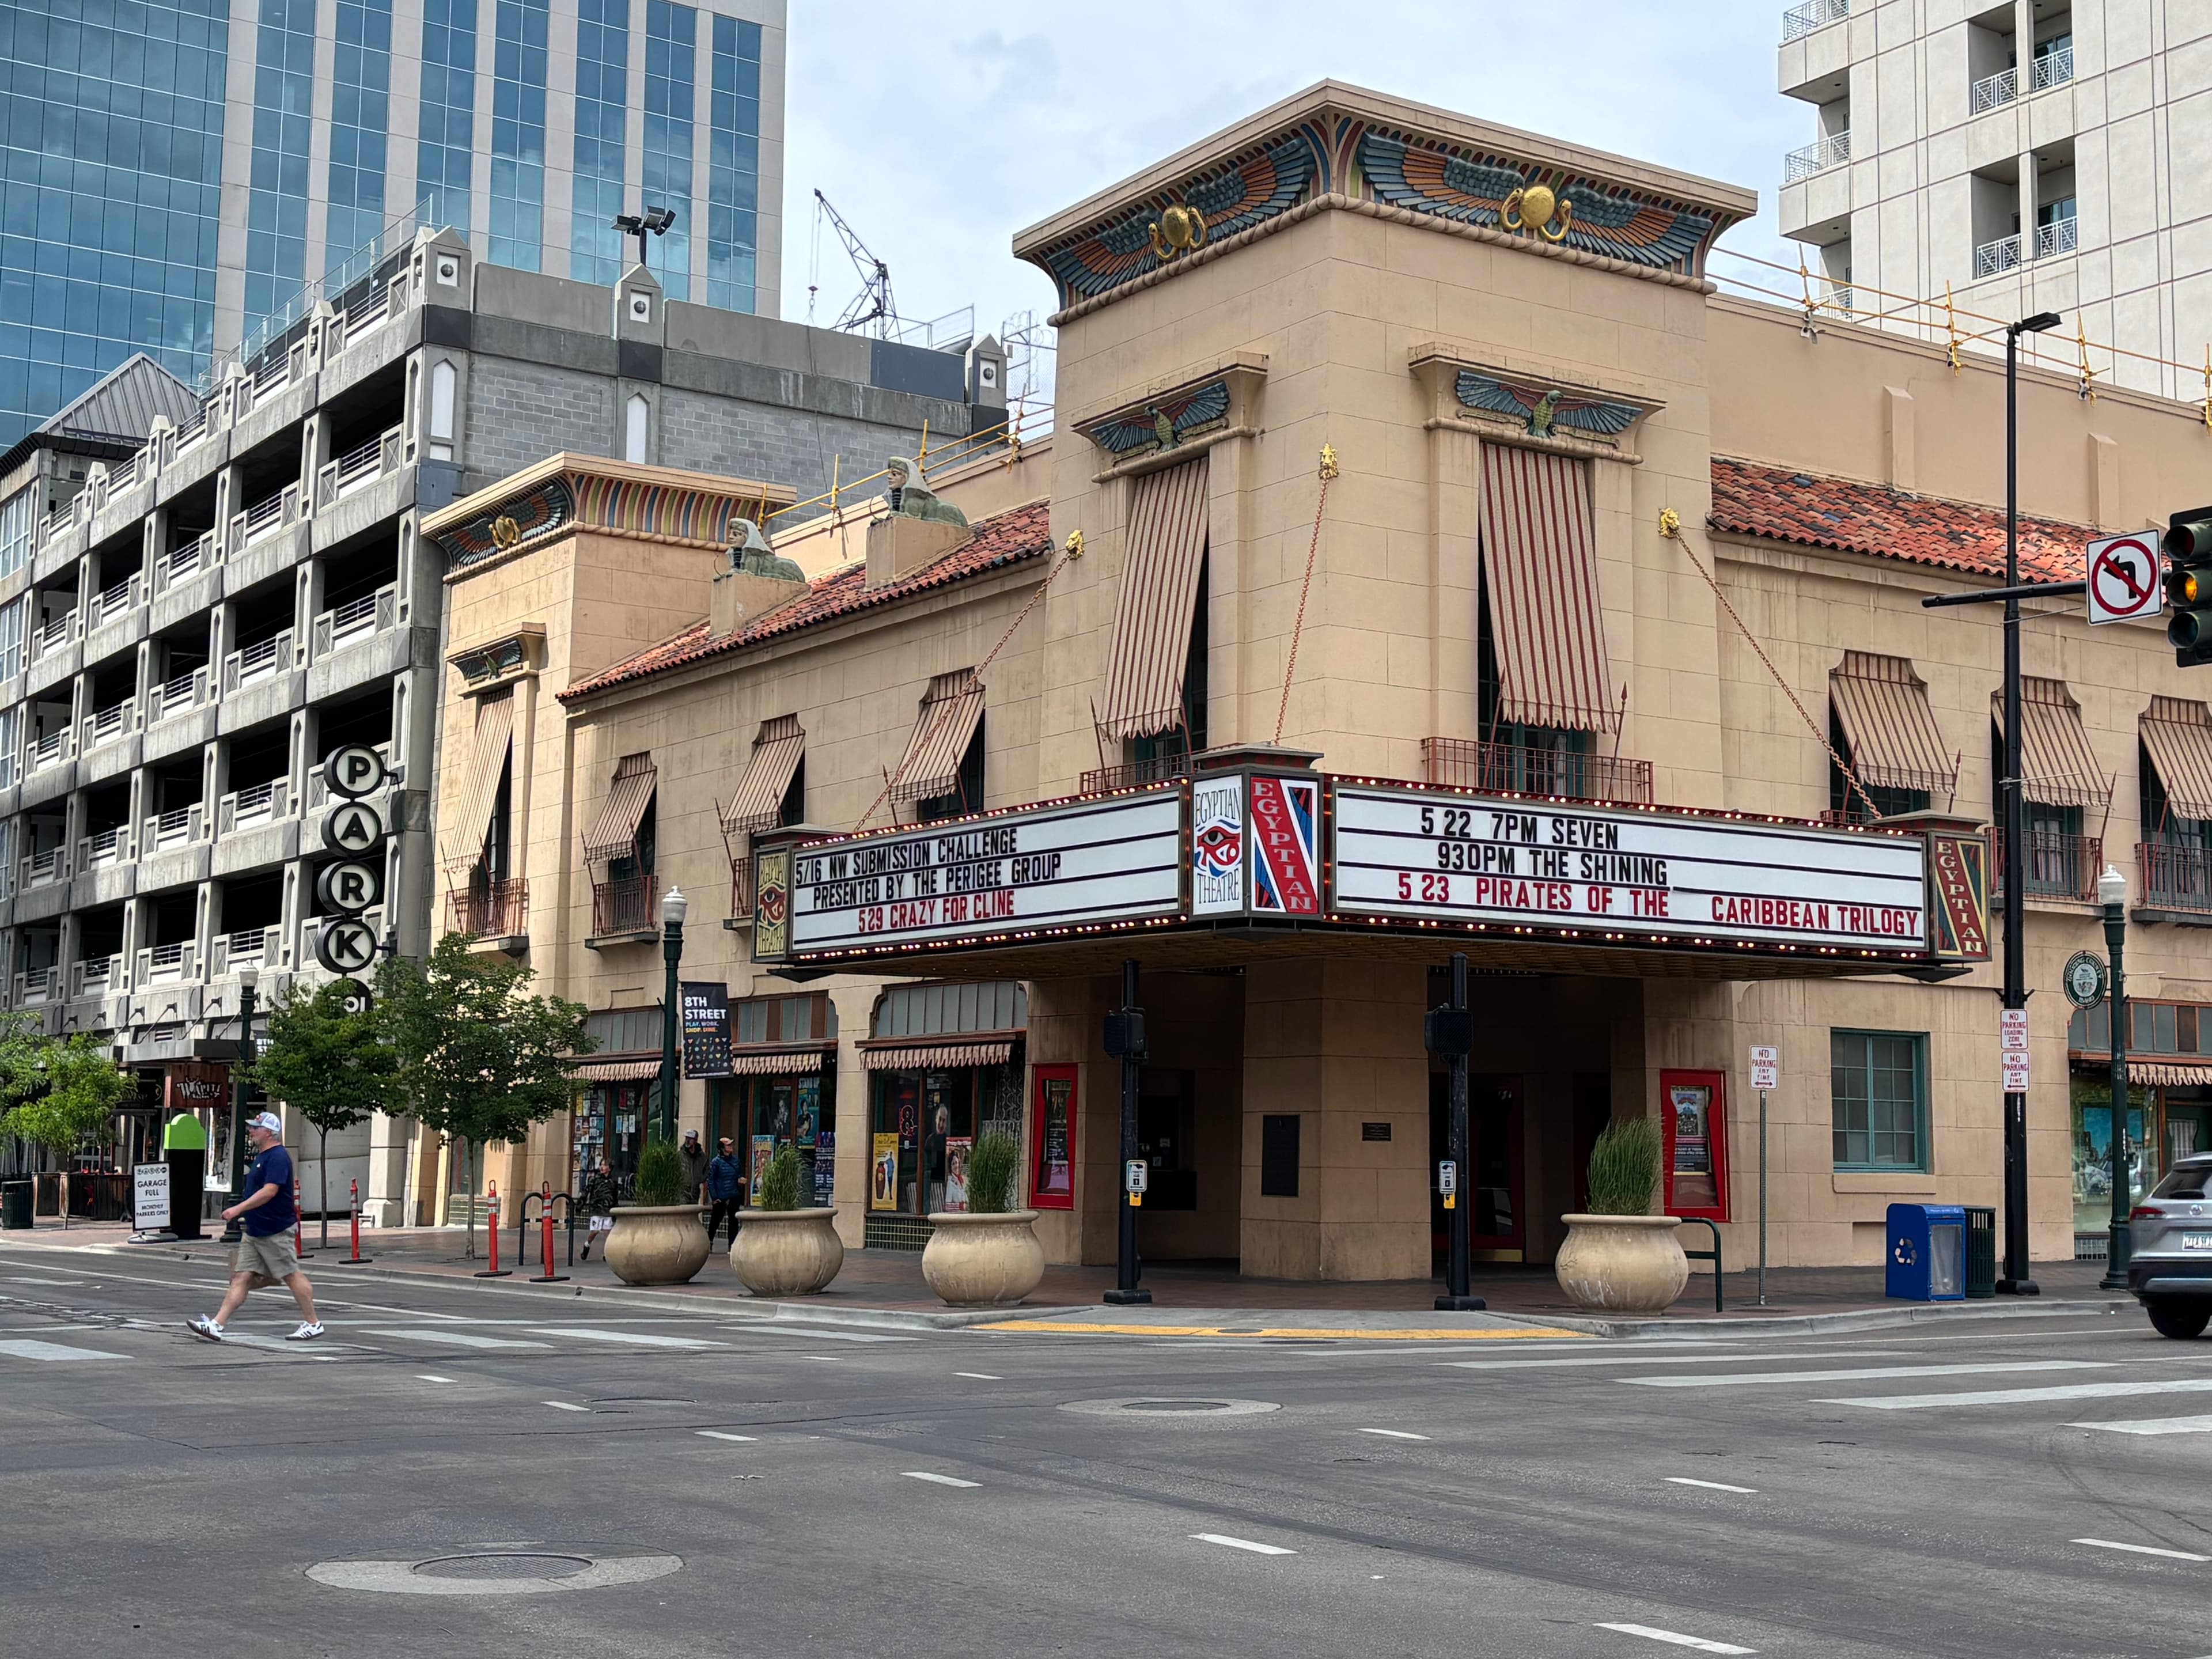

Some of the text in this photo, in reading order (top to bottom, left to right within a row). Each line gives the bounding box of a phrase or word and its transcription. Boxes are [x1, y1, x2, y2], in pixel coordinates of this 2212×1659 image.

[1195, 786, 1241, 827] EGYPTIAN
[1254, 782, 1312, 910] EGYPTIAN
[1422, 807, 1618, 849] 5 22 7PM SEVEN
[336, 756, 370, 959] PARK
[796, 828, 1017, 884] 5/16 NW SUBMISSION CHALLENGE
[1438, 843, 1666, 884] 930PM THE SHINING
[814, 854, 1060, 908] PRESENTED BY THE PERIGEE GROUP
[1198, 868, 1239, 904] THEATRE
[1937, 842, 1983, 953] EGYPTIAN
[859, 891, 1014, 933] 529 CRAZY FOR CLINE
[1399, 874, 1917, 934] 5 23 PIRATES OF THE CARIBBEAN TRILOGY
[684, 997, 707, 1007] 8TH
[685, 1009, 726, 1020] STREET
[1752, 1059, 1775, 1068] PARKING
[1759, 1050, 1769, 1058] NO
[2010, 1055, 2020, 1063] NO
[138, 1179, 167, 1188] GARAGE
